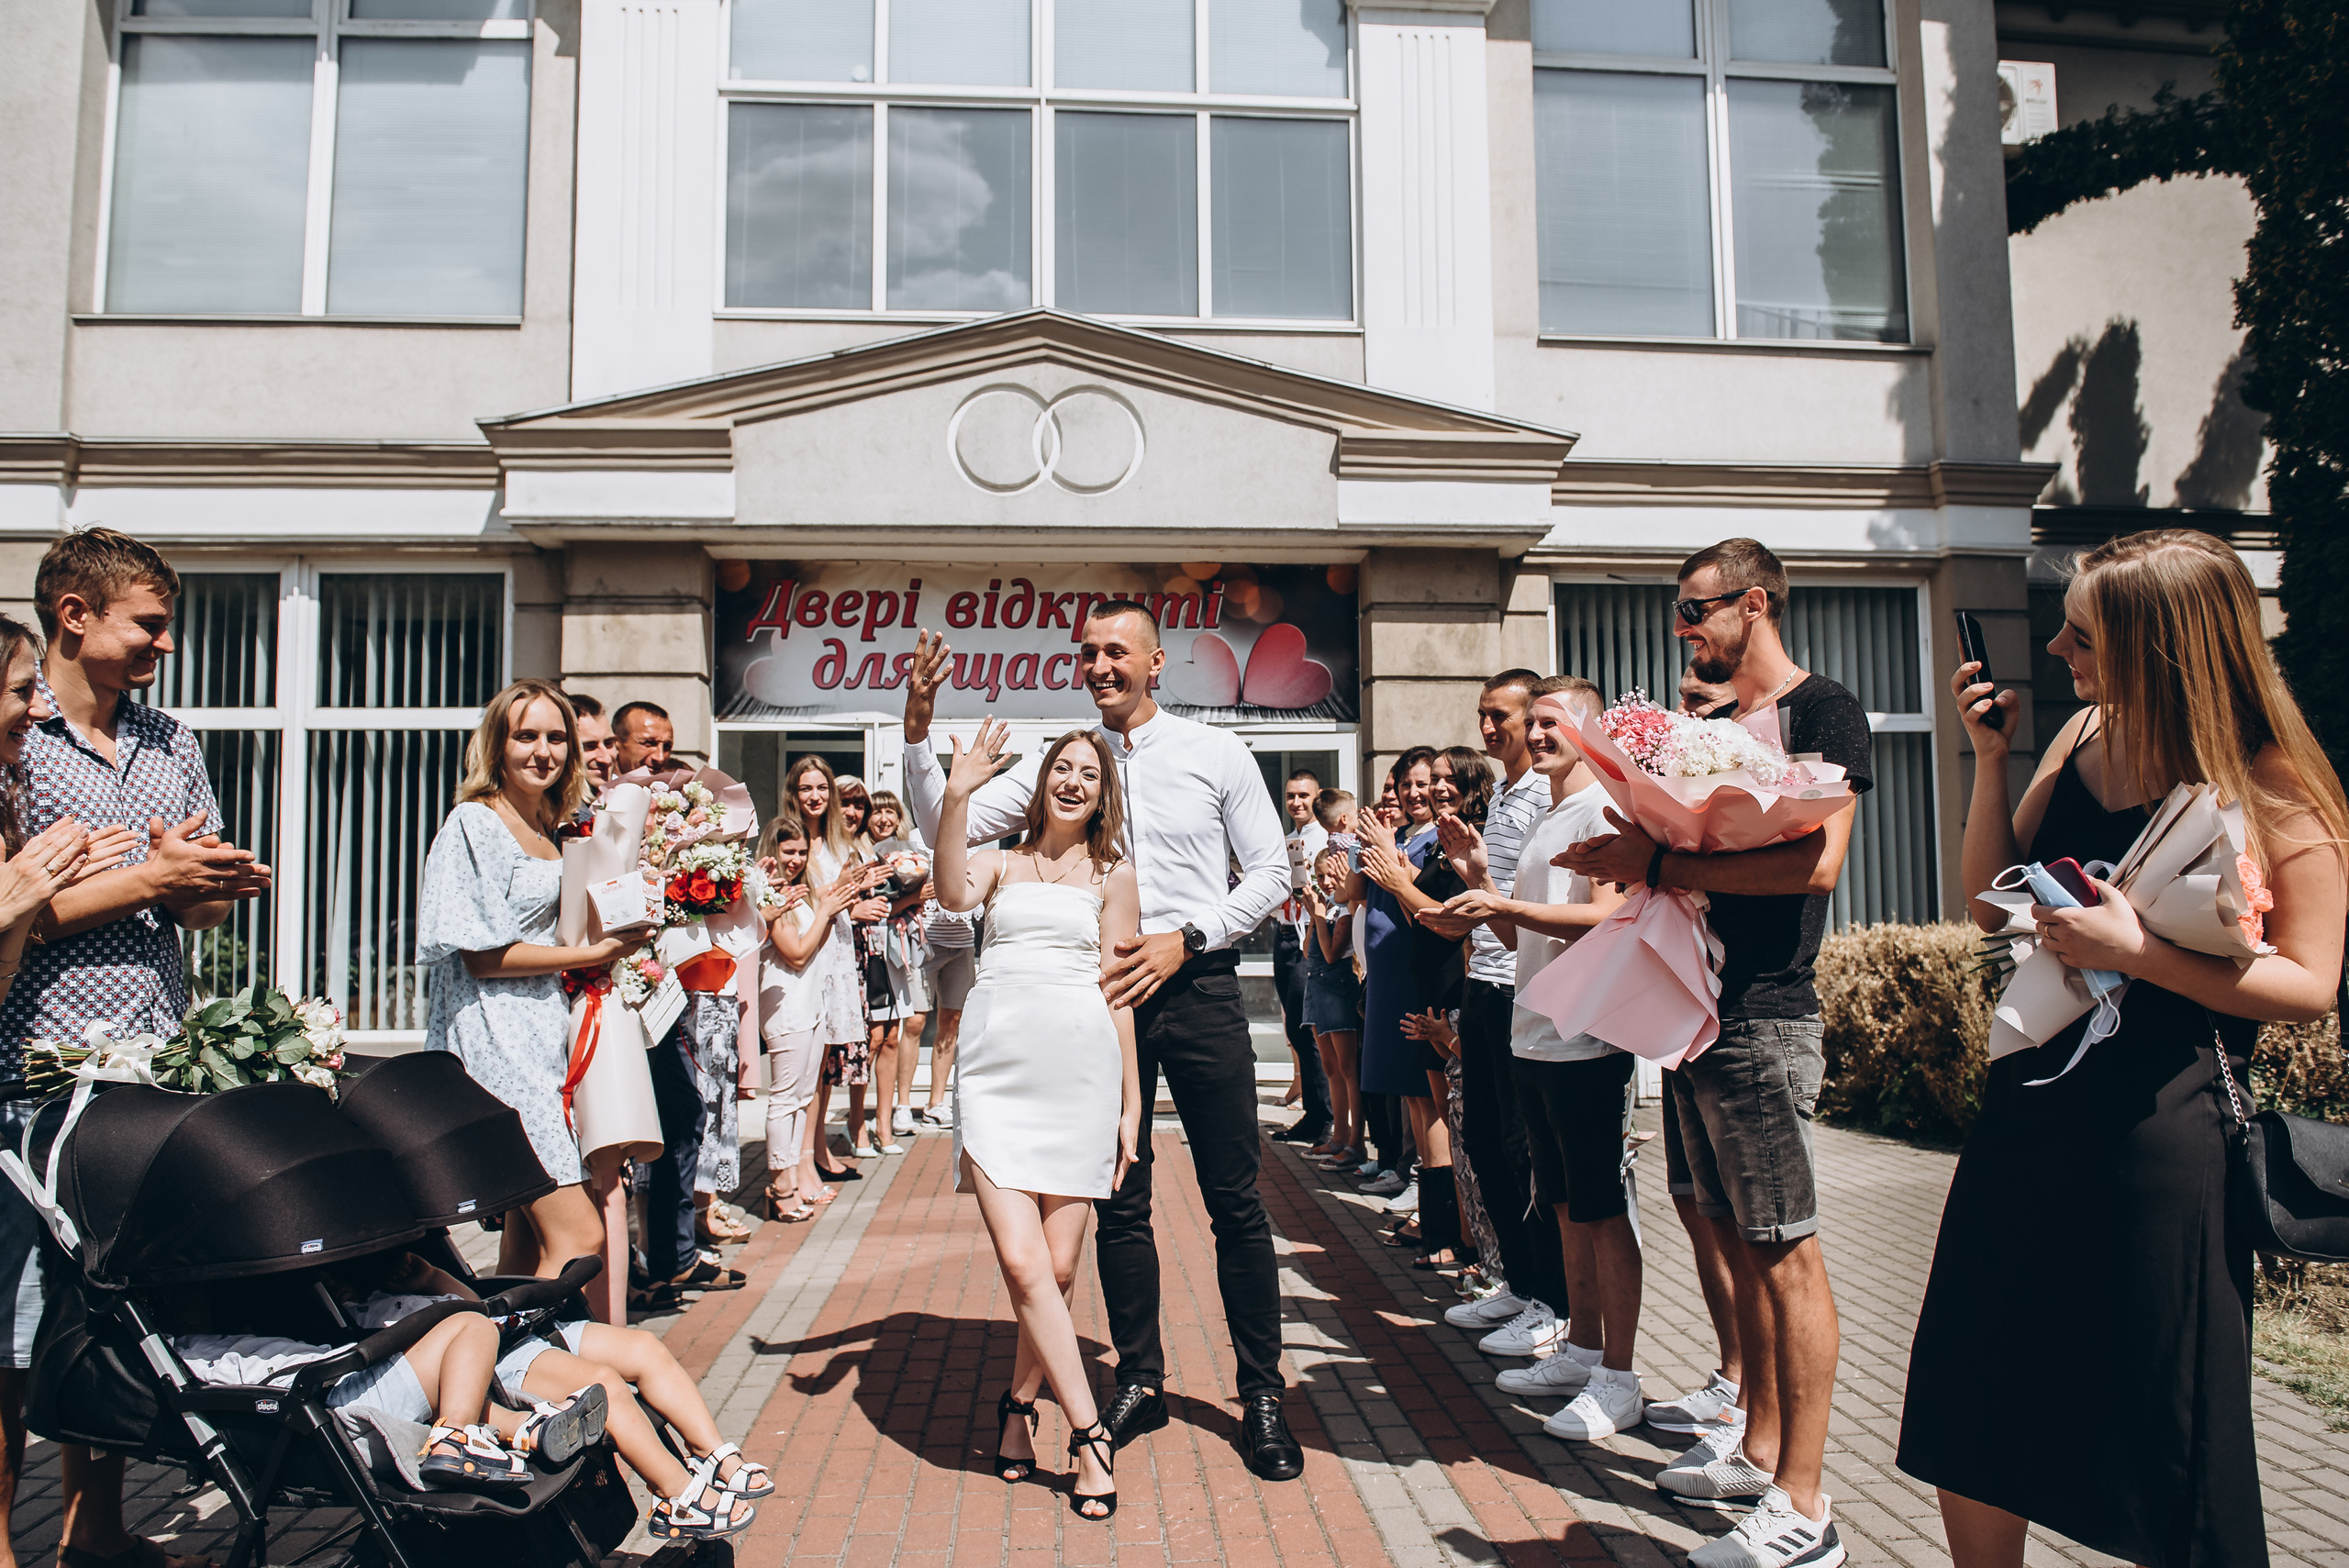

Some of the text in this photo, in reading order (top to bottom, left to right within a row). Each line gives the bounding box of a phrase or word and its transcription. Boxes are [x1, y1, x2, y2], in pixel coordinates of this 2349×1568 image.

[745, 577, 1223, 643] Двері відкрті
[812, 638, 1161, 703] для щас
[257, 1400, 278, 1411] chicco
